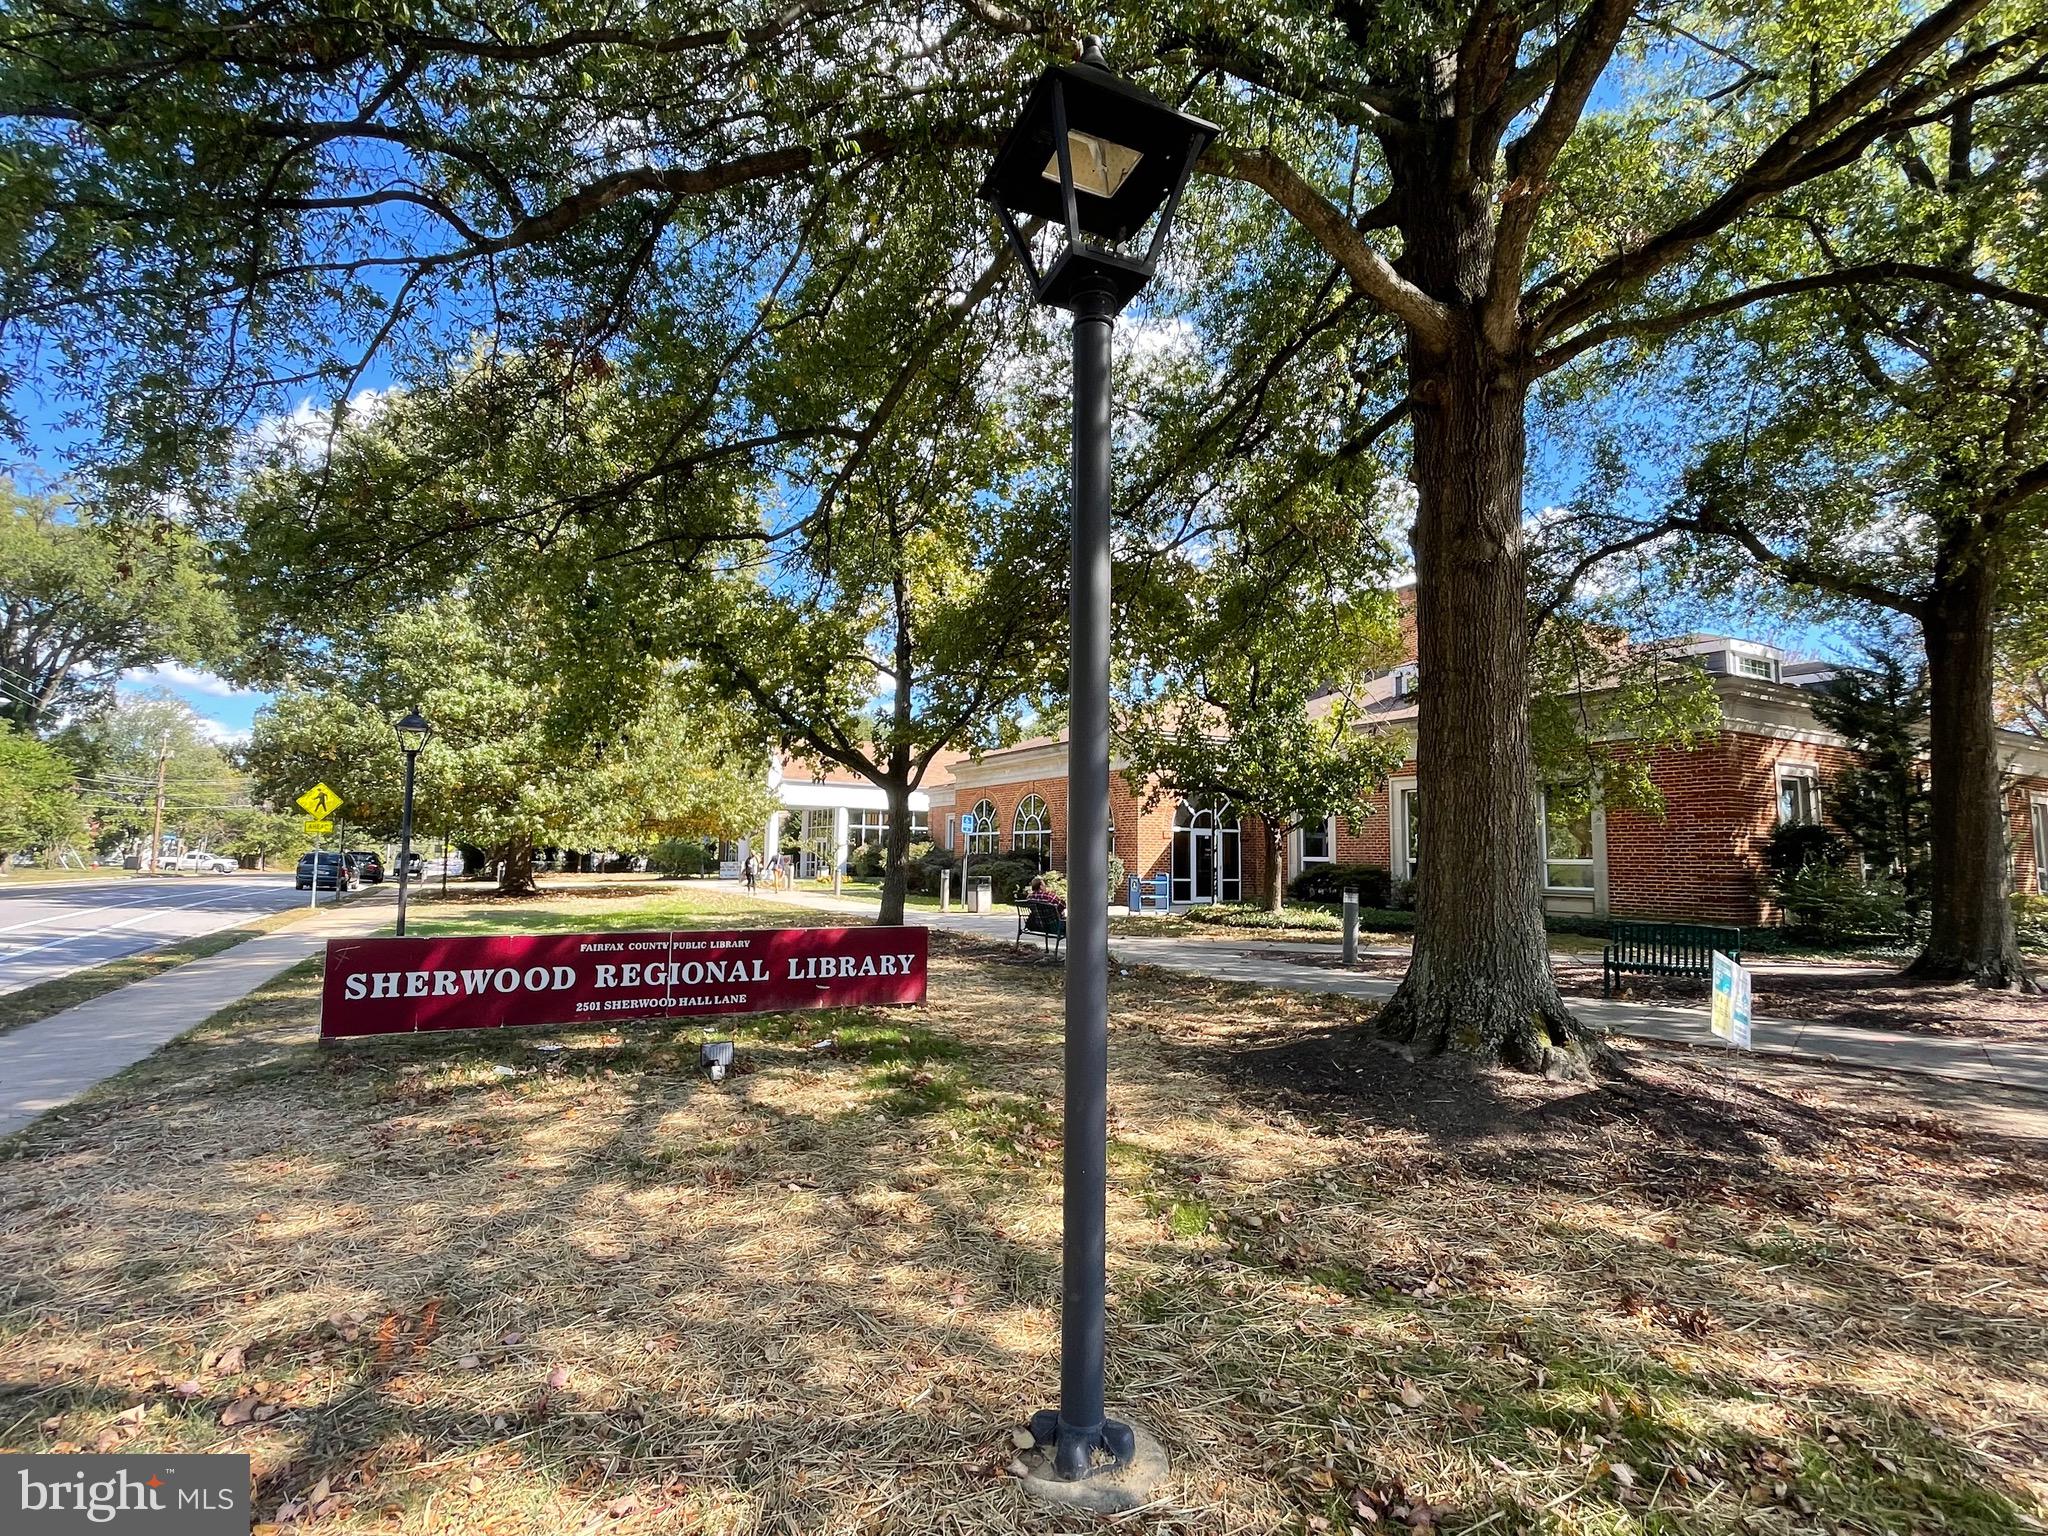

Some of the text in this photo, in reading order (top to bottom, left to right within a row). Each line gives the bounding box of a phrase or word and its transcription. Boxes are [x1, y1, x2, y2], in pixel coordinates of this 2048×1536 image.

[580, 940, 751, 952] FAIRFAX COUNTY PUBLIC LIBRARY
[344, 954, 916, 1001] SHERWOOD REGIONAL LIBRARY
[576, 994, 747, 1012] 2501 SHERWOOD HALL LANE
